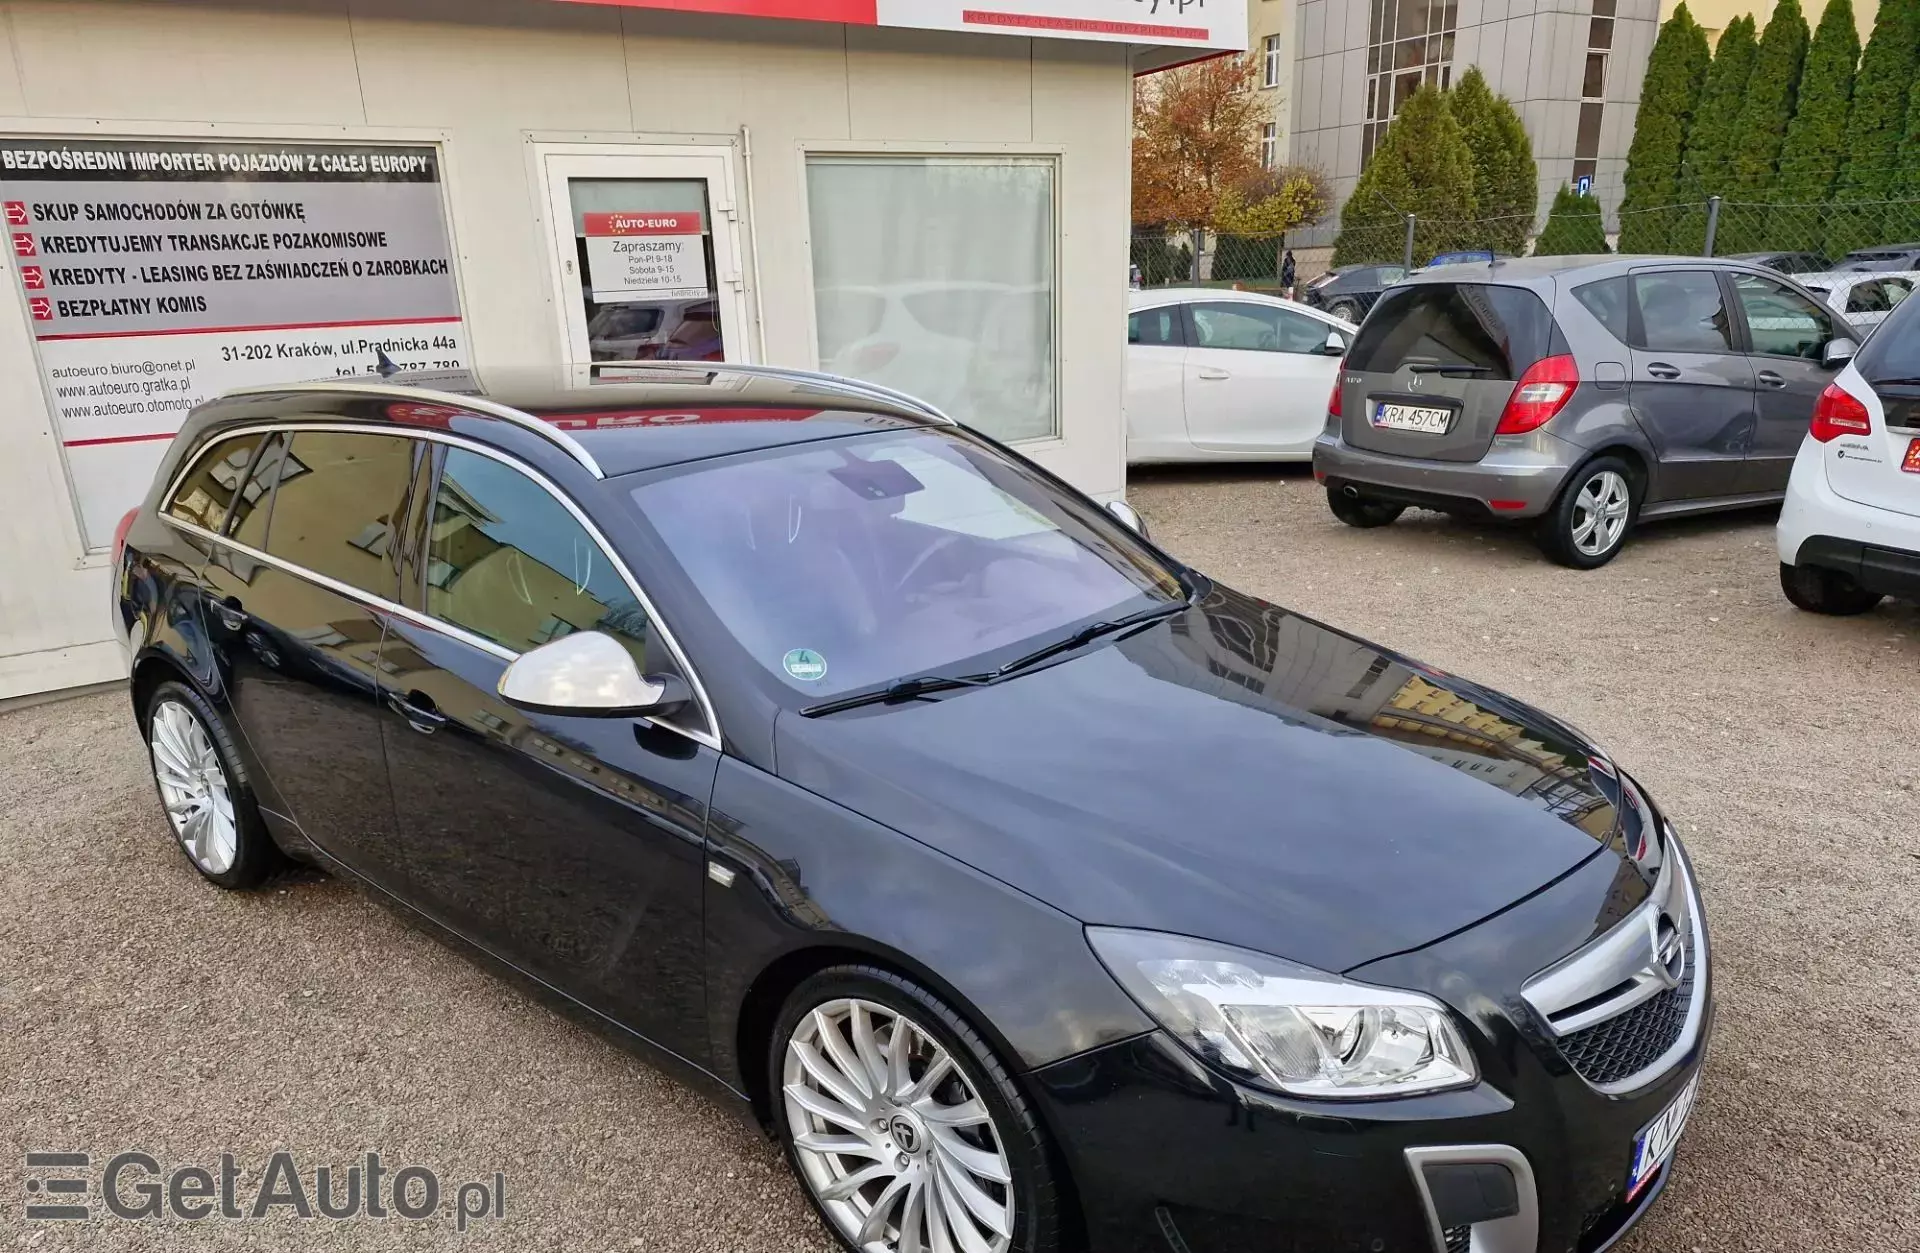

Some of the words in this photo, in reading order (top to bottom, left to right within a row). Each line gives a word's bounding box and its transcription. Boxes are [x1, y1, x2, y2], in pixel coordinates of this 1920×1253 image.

[2, 147, 126, 170] BEZPOŚREDNI
[129, 152, 216, 171] IMPORTER
[219, 151, 303, 172] POJAZDÓW
[307, 155, 318, 172] Z
[321, 155, 367, 172] CAŁEJ
[371, 156, 427, 173] EUROPY
[33, 203, 79, 222] SKUP
[85, 200, 201, 222] SAMOCHODÓW
[205, 203, 227, 220] ZA
[231, 200, 306, 223] GOTÓWKĘ
[616, 219, 677, 228] AUTO-EURO
[41, 235, 163, 254] KREDYTUJEMY
[168, 233, 270, 251] TRANSAKCJE
[273, 231, 387, 250] POZAKOMISOWE
[49, 267, 126, 286] KREDYTY
[140, 265, 209, 283] LEASING
[213, 264, 243, 281] BEZ
[246, 258, 349, 280] ZAŚWIADCZEŃ
[353, 261, 362, 277] O
[366, 259, 449, 276] ZAROBKACH
[624, 276, 658, 285] Niedziela
[661, 275, 682, 284] 10-15
[629, 266, 656, 274] Sobota
[658, 265, 674, 273] 9-15
[57, 298, 151, 318] BEZPŁATNY
[156, 296, 207, 313] KOMIS
[221, 344, 273, 362] 31-202
[276, 341, 338, 359] Kraków,
[432, 335, 456, 350] 44a
[52, 359, 196, 378] autoeuro.biuro@onet.pl
[56, 376, 191, 398] www.autoeuro.gratka.pl
[1383, 406, 1404, 424] KRA
[1408, 408, 1449, 428] 457CM
